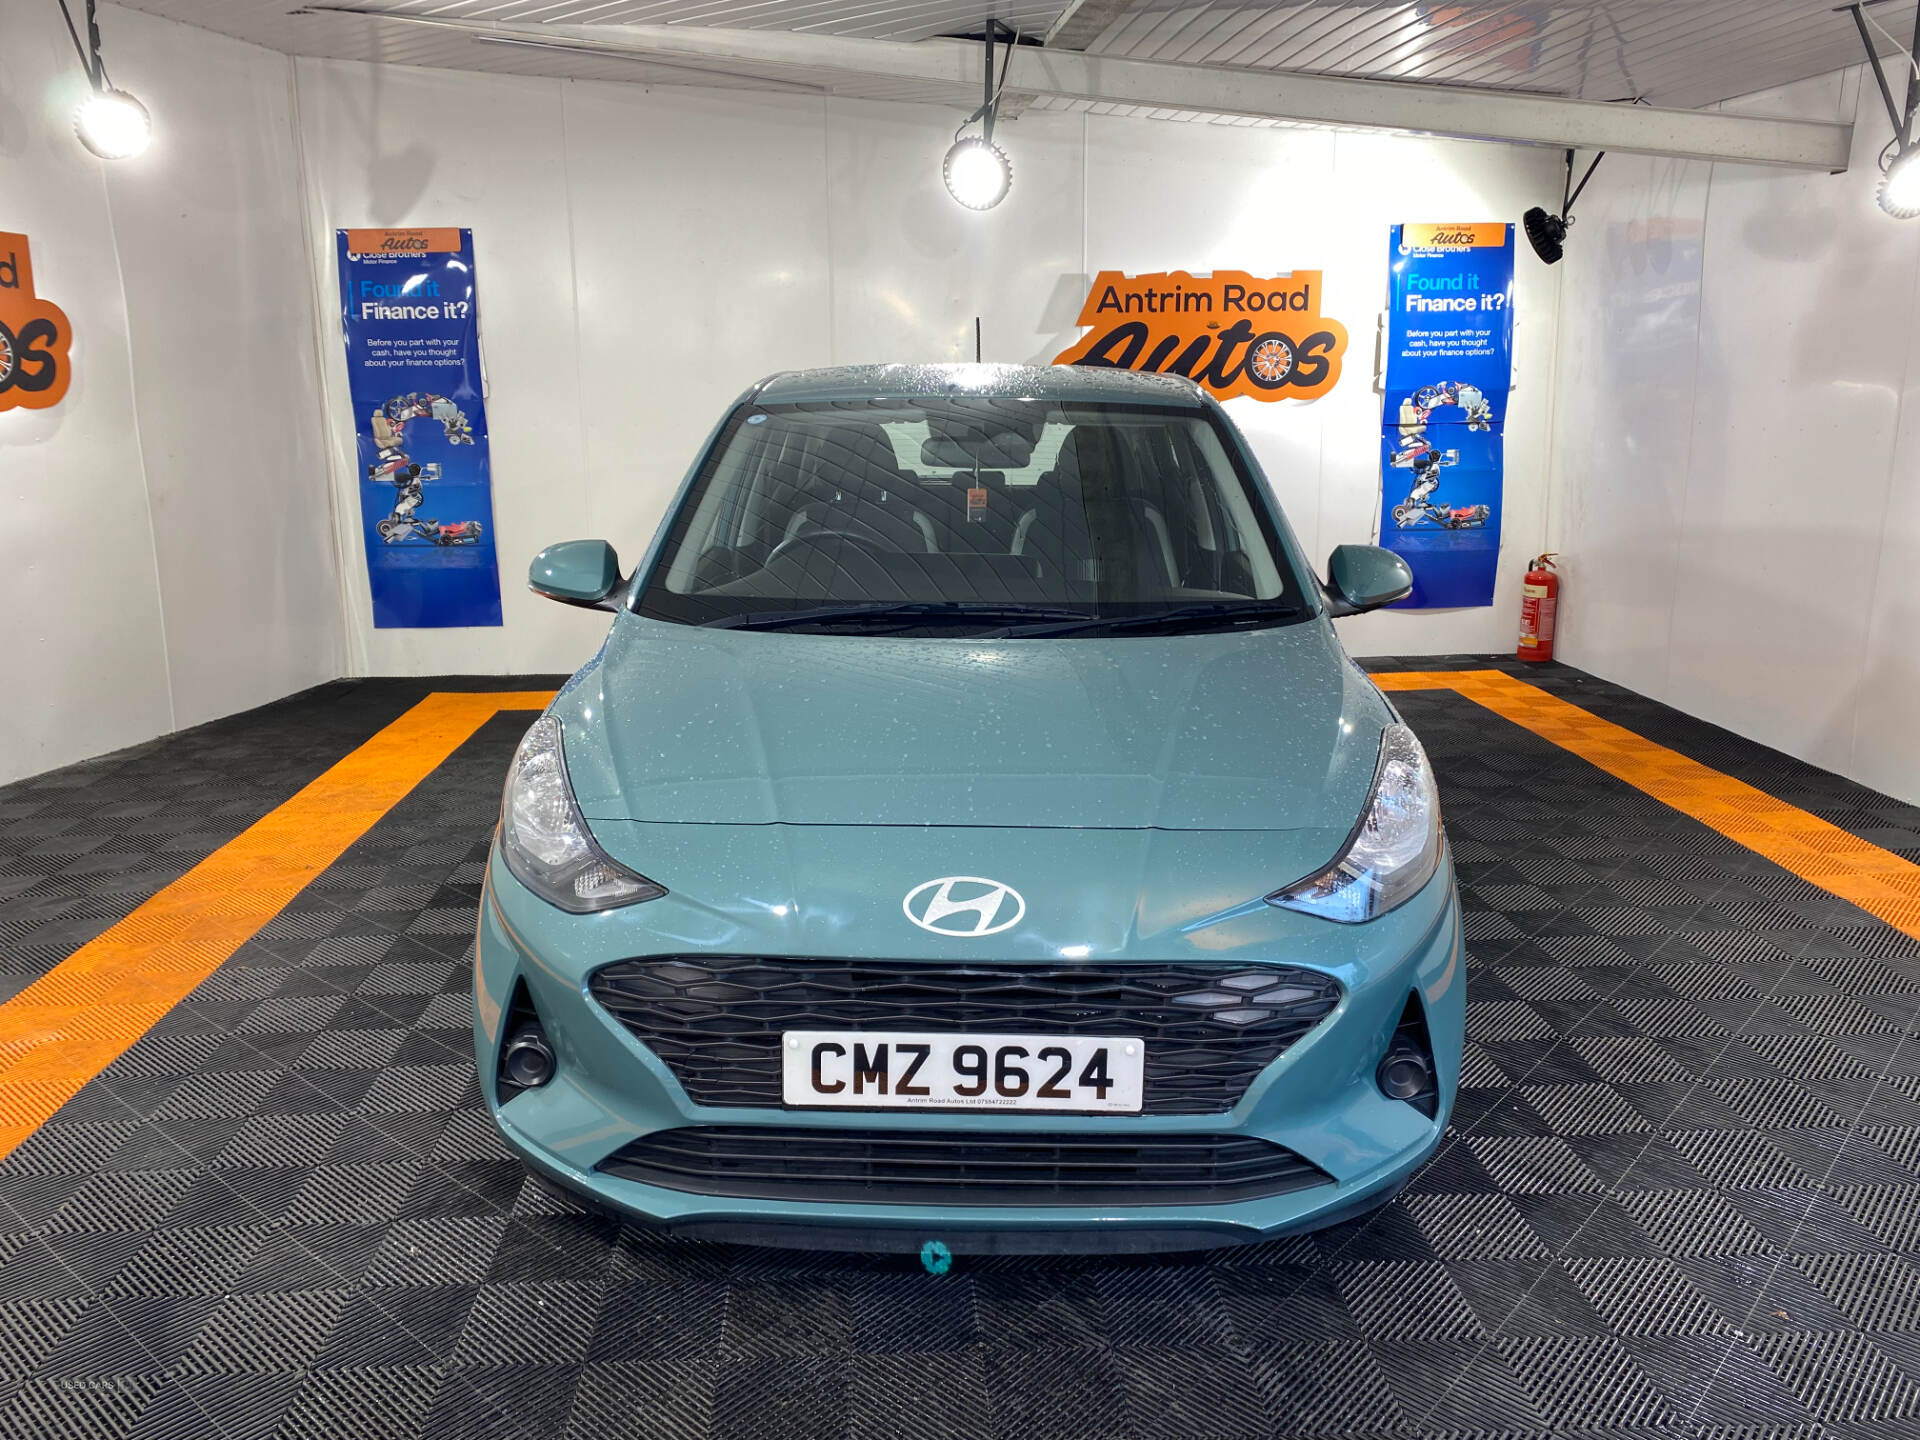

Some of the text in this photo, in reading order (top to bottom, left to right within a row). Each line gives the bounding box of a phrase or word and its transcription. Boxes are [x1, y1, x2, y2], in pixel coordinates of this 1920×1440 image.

[381, 237, 429, 250] Autos
[1430, 232, 1475, 244] Autos
[426, 280, 440, 297] it
[1407, 273, 1480, 291] Found it
[1096, 284, 1310, 313] Antrim Road
[1406, 293, 1505, 312] Finance it?
[362, 301, 468, 320] Finance it?
[1444, 330, 1458, 338] part
[367, 338, 459, 348] Before you part with your
[1461, 339, 1488, 348] thought
[428, 349, 456, 358] thought
[1077, 319, 1336, 390] Autos
[1439, 349, 1464, 357] finance
[1465, 348, 1494, 358] options?
[364, 358, 465, 369] about your finance options?
[811, 1042, 1113, 1100] CMZ 9624
